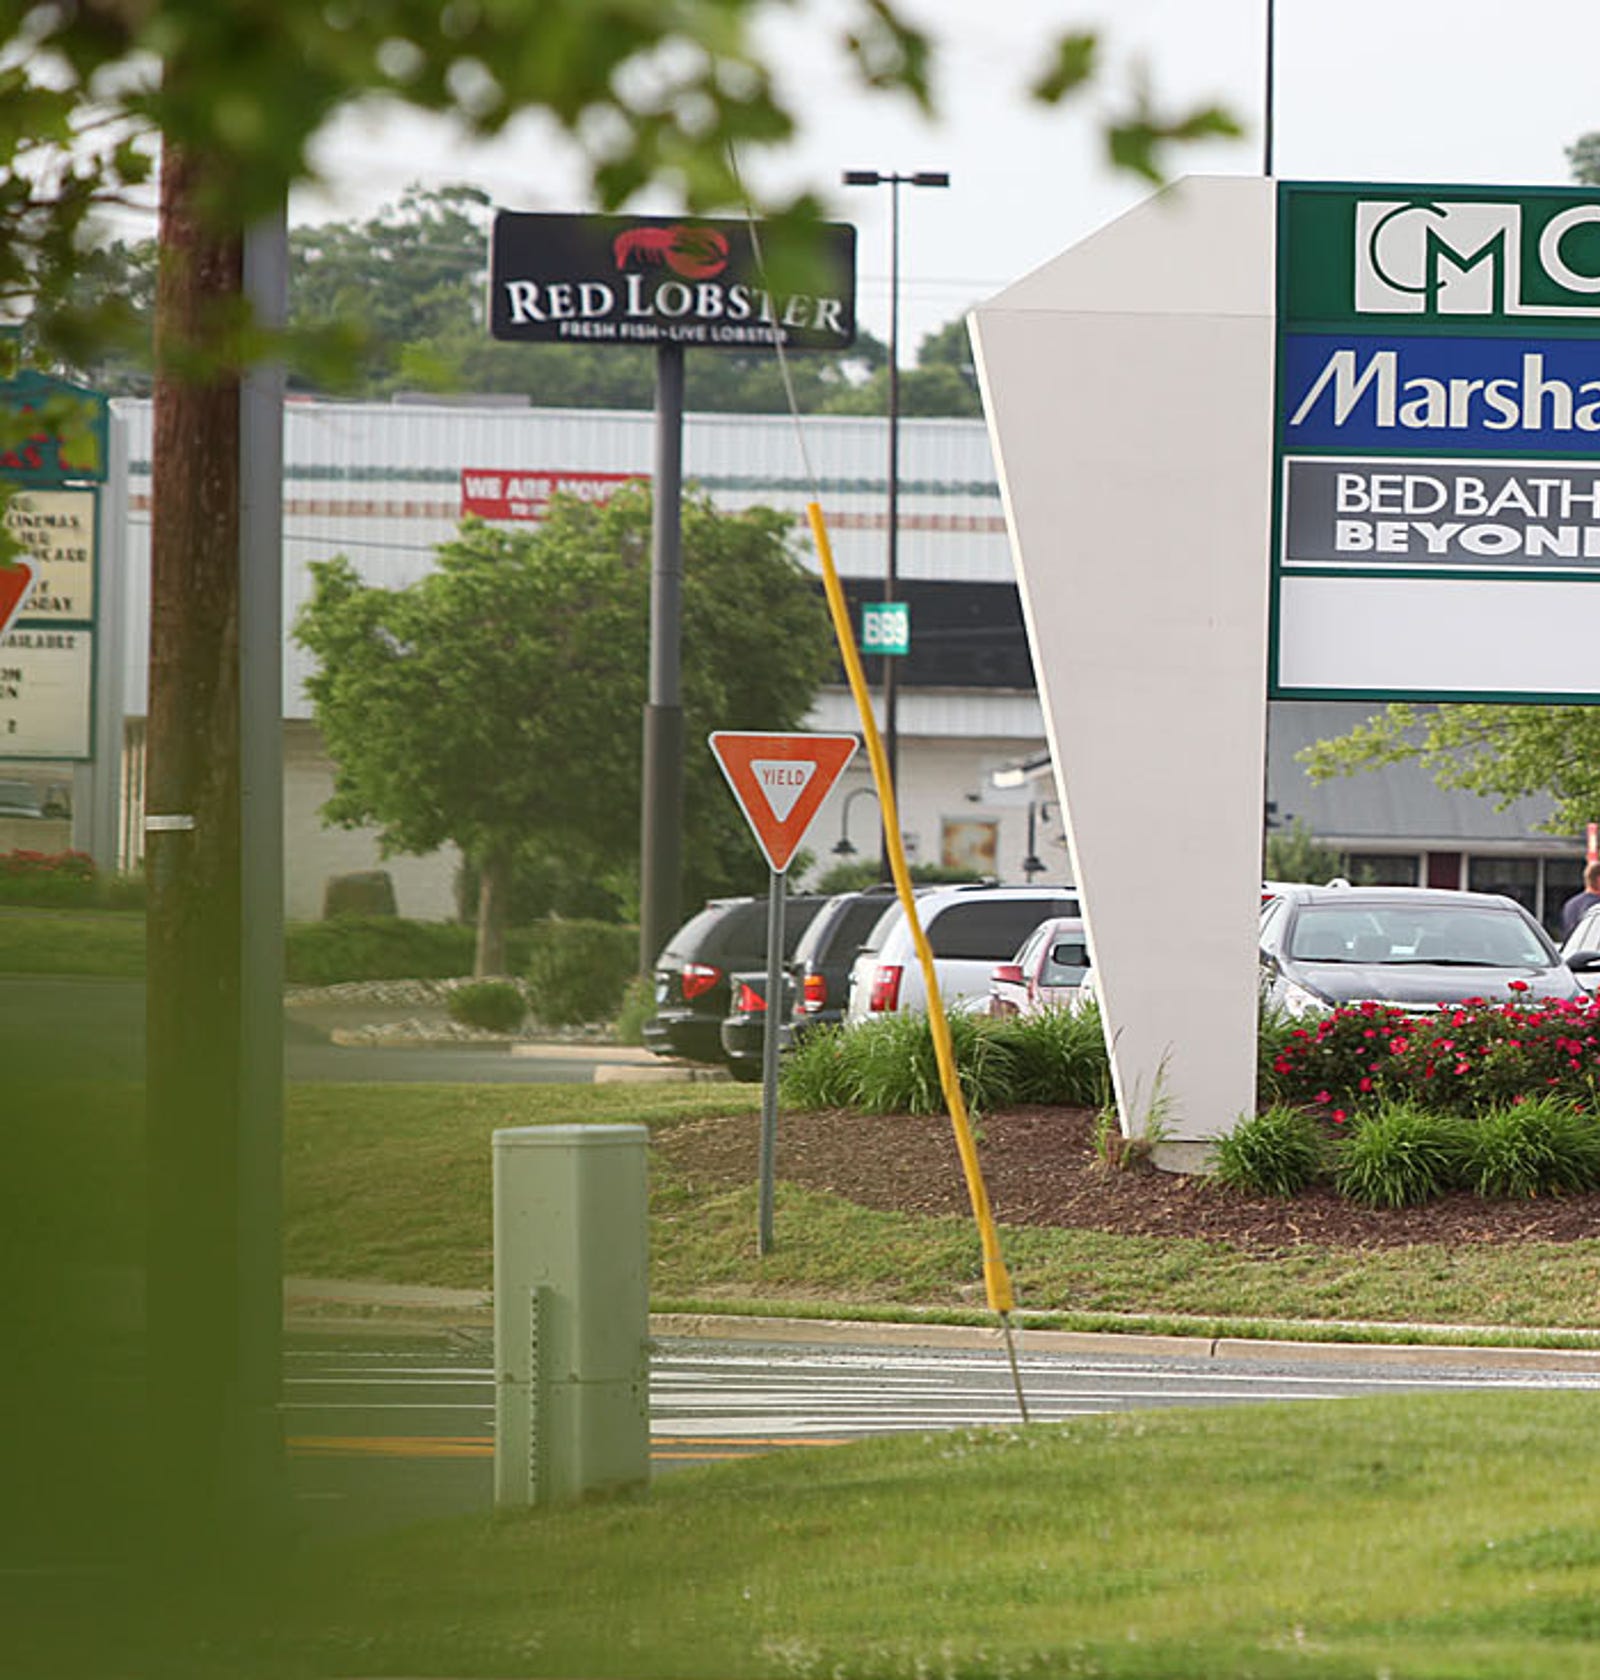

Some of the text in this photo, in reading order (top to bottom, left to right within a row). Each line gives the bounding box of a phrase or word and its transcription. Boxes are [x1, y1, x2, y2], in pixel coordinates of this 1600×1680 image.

[506, 273, 845, 333] RED LOBSTER
[560, 321, 616, 337] FRESH
[465, 476, 500, 499] WE
[507, 477, 549, 500] ARE
[1336, 473, 1448, 515] BED
[762, 768, 806, 786] YIELD
